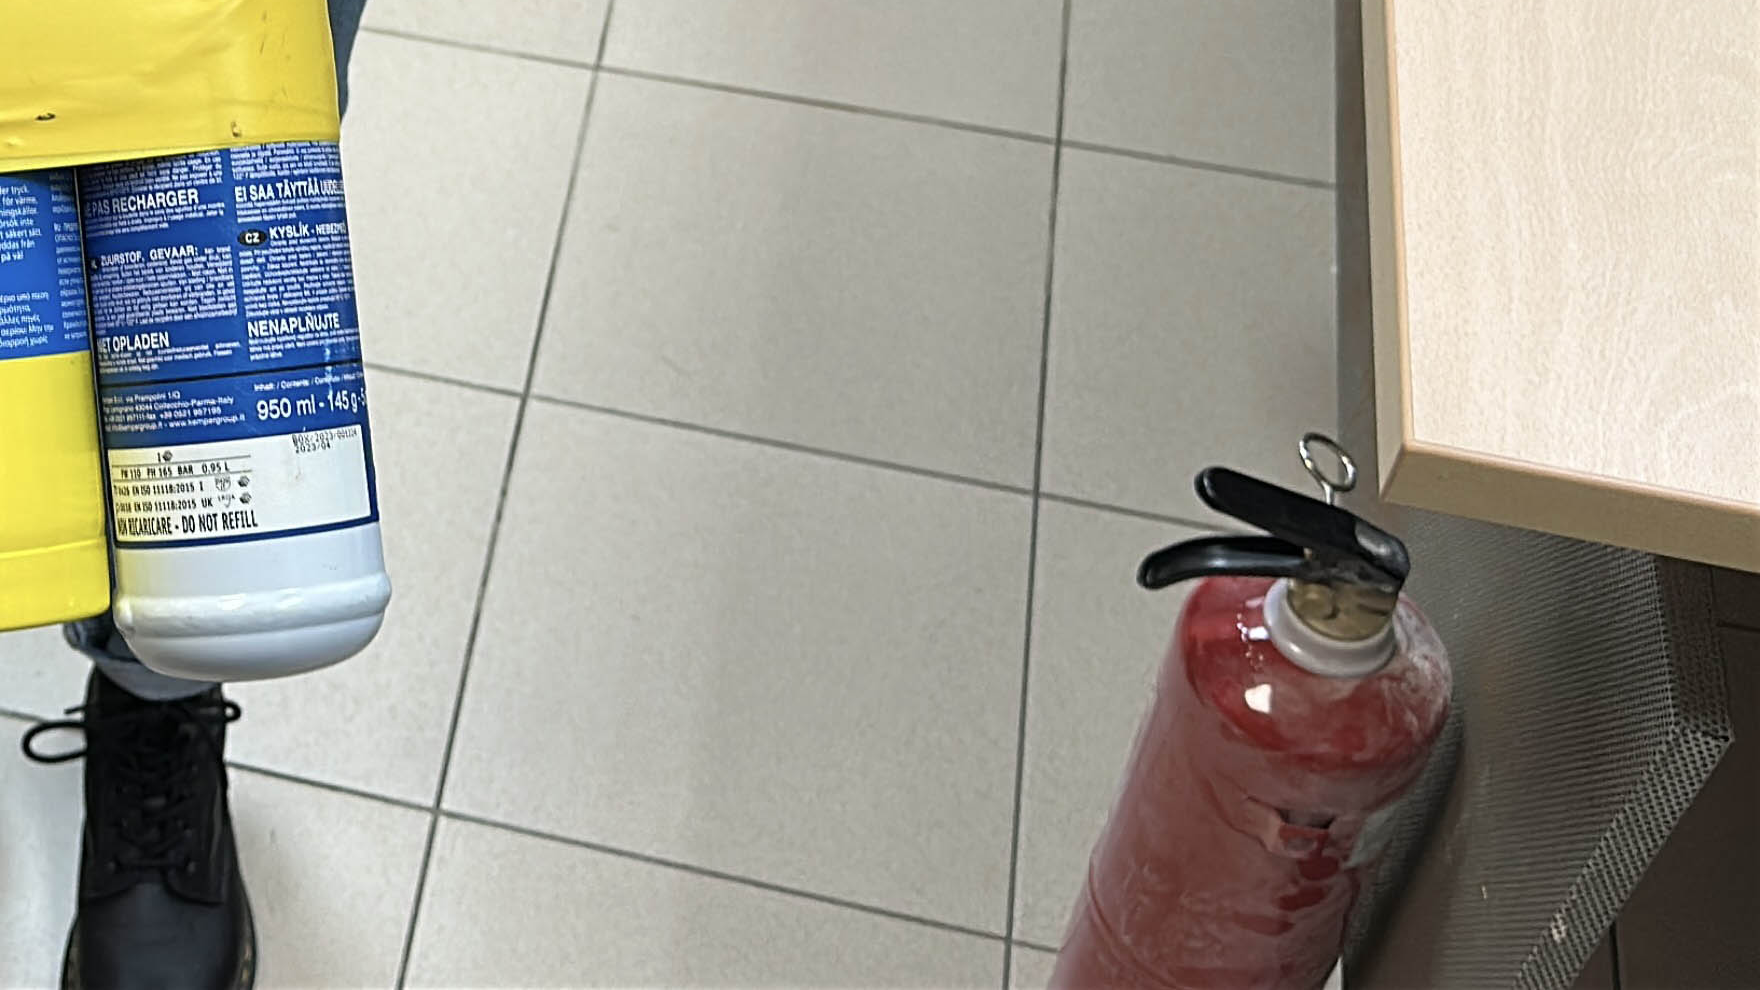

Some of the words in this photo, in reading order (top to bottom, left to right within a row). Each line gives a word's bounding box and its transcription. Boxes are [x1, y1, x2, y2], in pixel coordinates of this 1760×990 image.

[112, 188, 199, 213] RECHARGER
[235, 186, 248, 202] EI
[249, 183, 275, 201] SAA
[276, 177, 320, 199] TÄYTTÄÄ
[5, 229, 28, 240] säkert
[245, 233, 260, 243] CZ
[269, 221, 310, 239] KYSLÍK
[1, 253, 11, 263] på
[12, 250, 24, 260] väl
[101, 251, 145, 267] ZUURSTOF.
[150, 244, 198, 261] GEVAAR:
[247, 312, 340, 337] NENAPLŇUJTE
[112, 331, 171, 354] OPLADEN
[256, 397, 292, 421] 950
[296, 394, 317, 415] ml
[328, 390, 349, 412] 145
[351, 392, 358, 413] g
[147, 468, 156, 477] PH
[177, 465, 194, 475] BAR
[201, 462, 222, 474] 0.95
[224, 461, 231, 471] L
[153, 482, 195, 495] 11118:2015
[154, 499, 197, 511] 11118:2015
[201, 498, 213, 508] UK
[128, 516, 173, 535] RICARICARE
[182, 514, 196, 533] DO
[198, 513, 218, 532] NOT
[221, 509, 258, 530] REFILL
